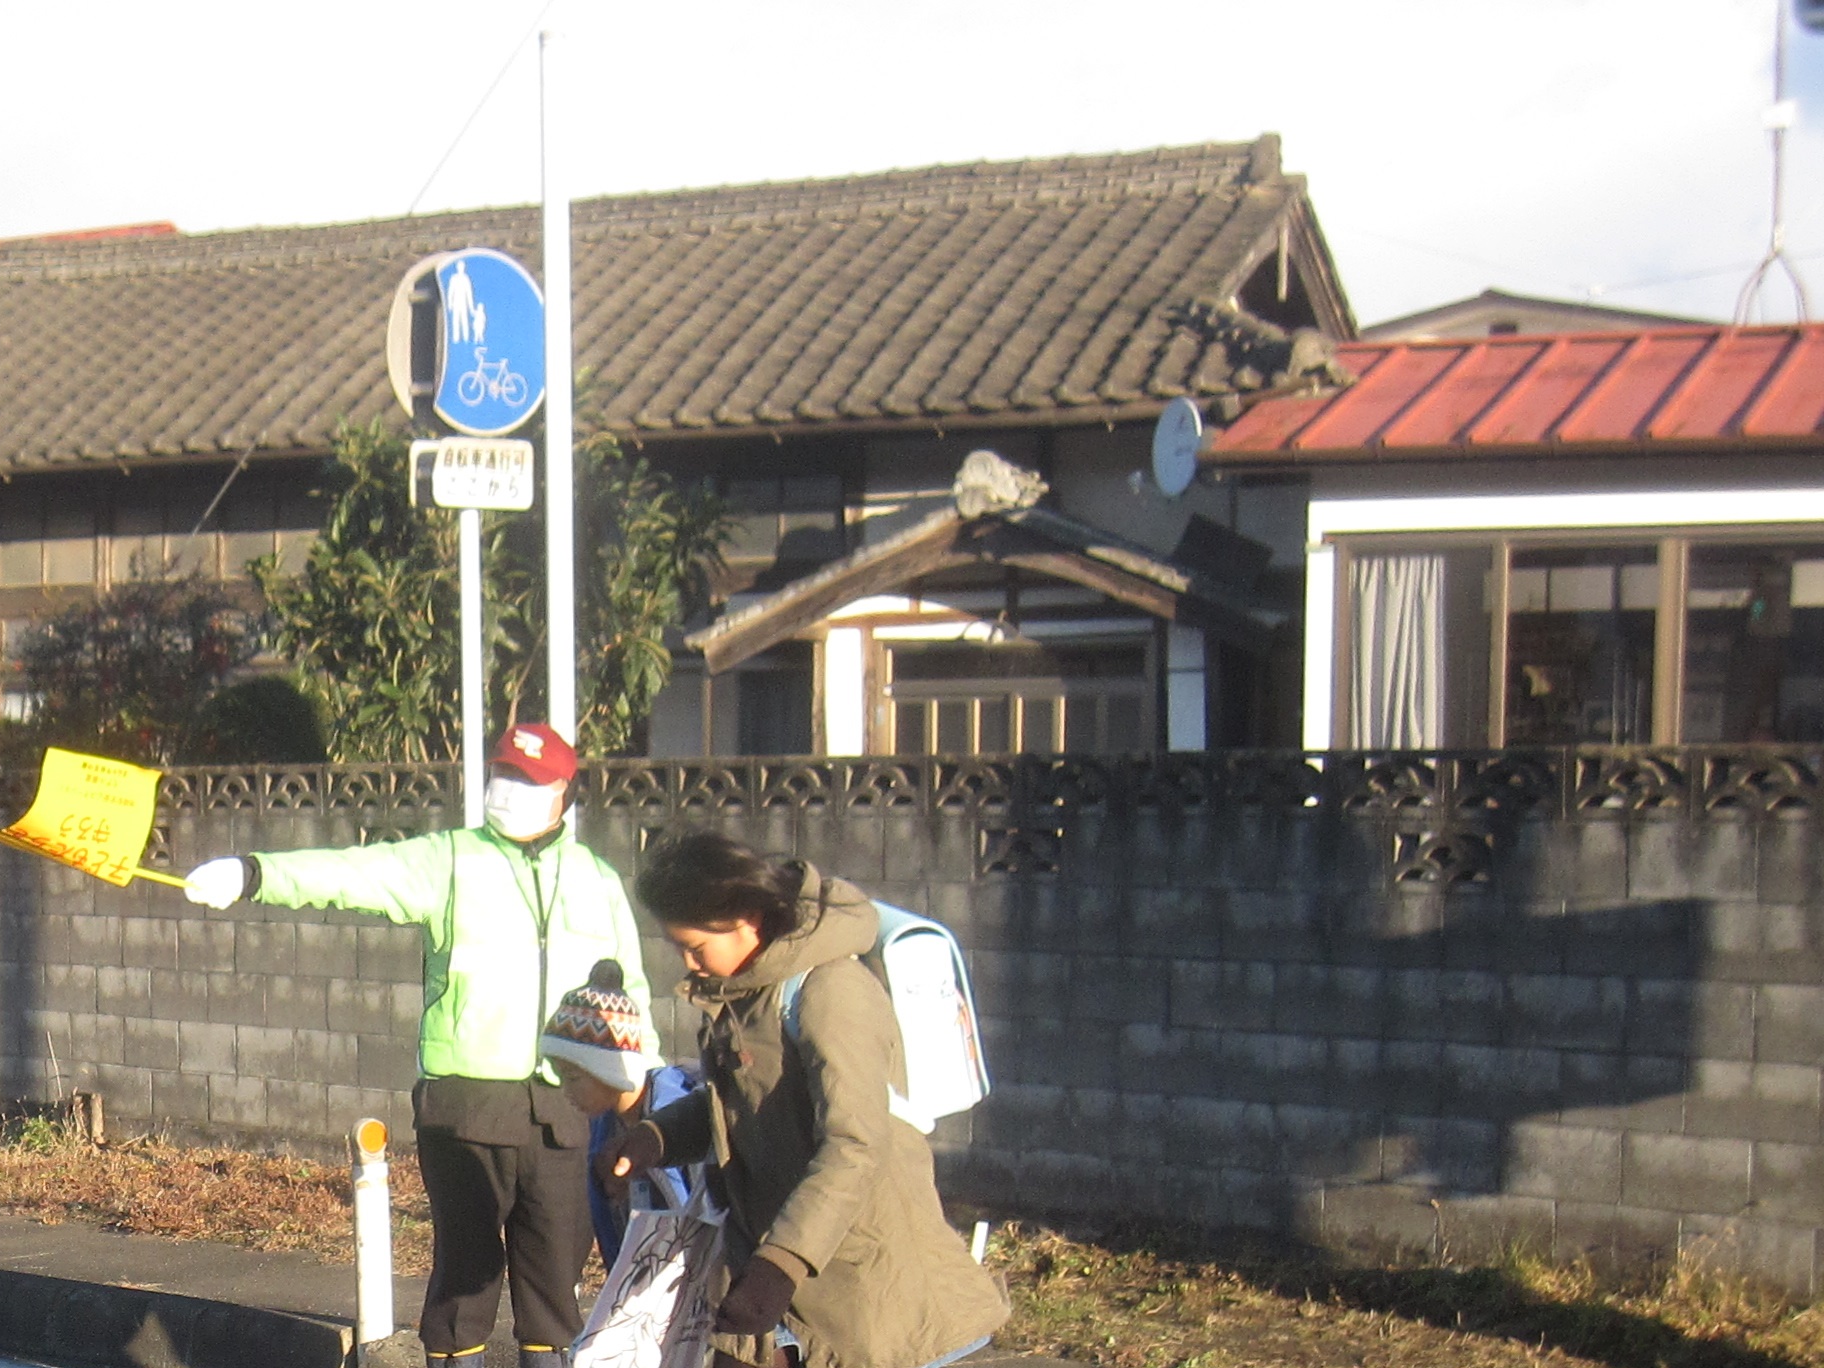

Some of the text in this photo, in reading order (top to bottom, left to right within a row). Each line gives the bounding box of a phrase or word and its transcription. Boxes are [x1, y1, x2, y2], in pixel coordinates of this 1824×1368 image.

[447, 476, 519, 498] ここから
[59, 814, 111, 844] 守ろう
